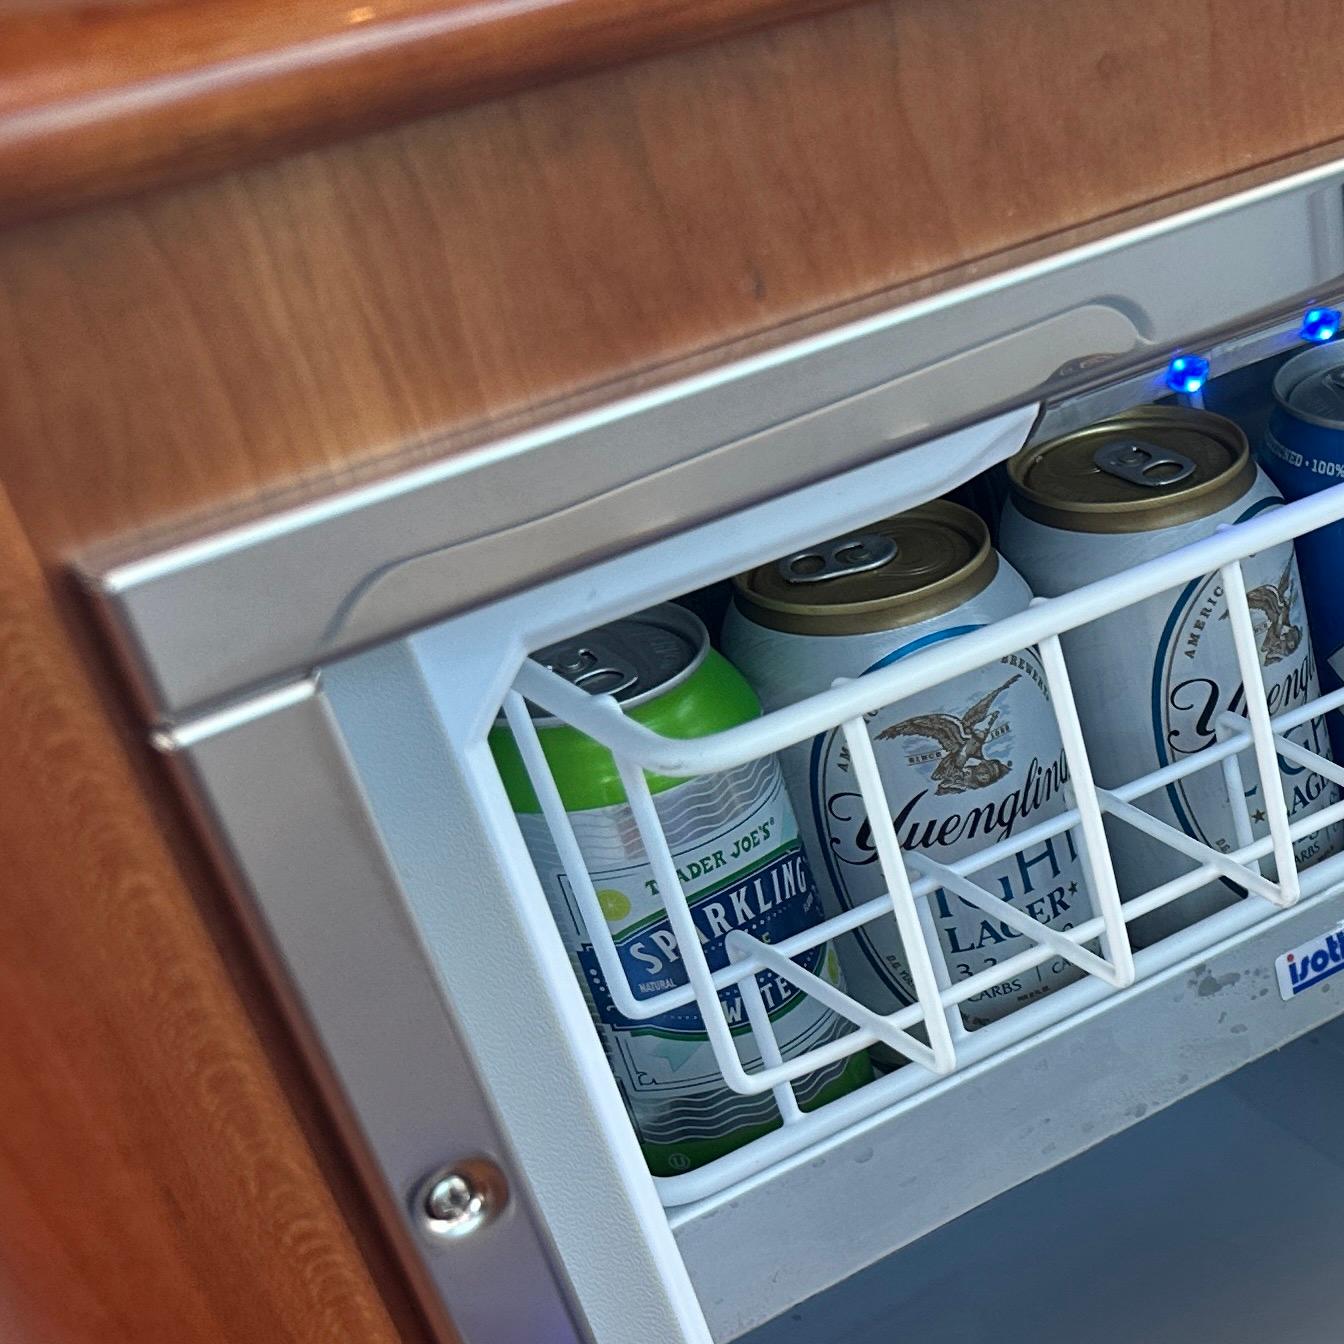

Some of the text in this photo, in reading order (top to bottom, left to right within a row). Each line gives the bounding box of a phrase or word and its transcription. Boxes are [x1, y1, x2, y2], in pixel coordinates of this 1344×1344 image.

[644, 850, 727, 896] TADER
[638, 977, 678, 994] NATURAL
[720, 976, 793, 1024] WTE
